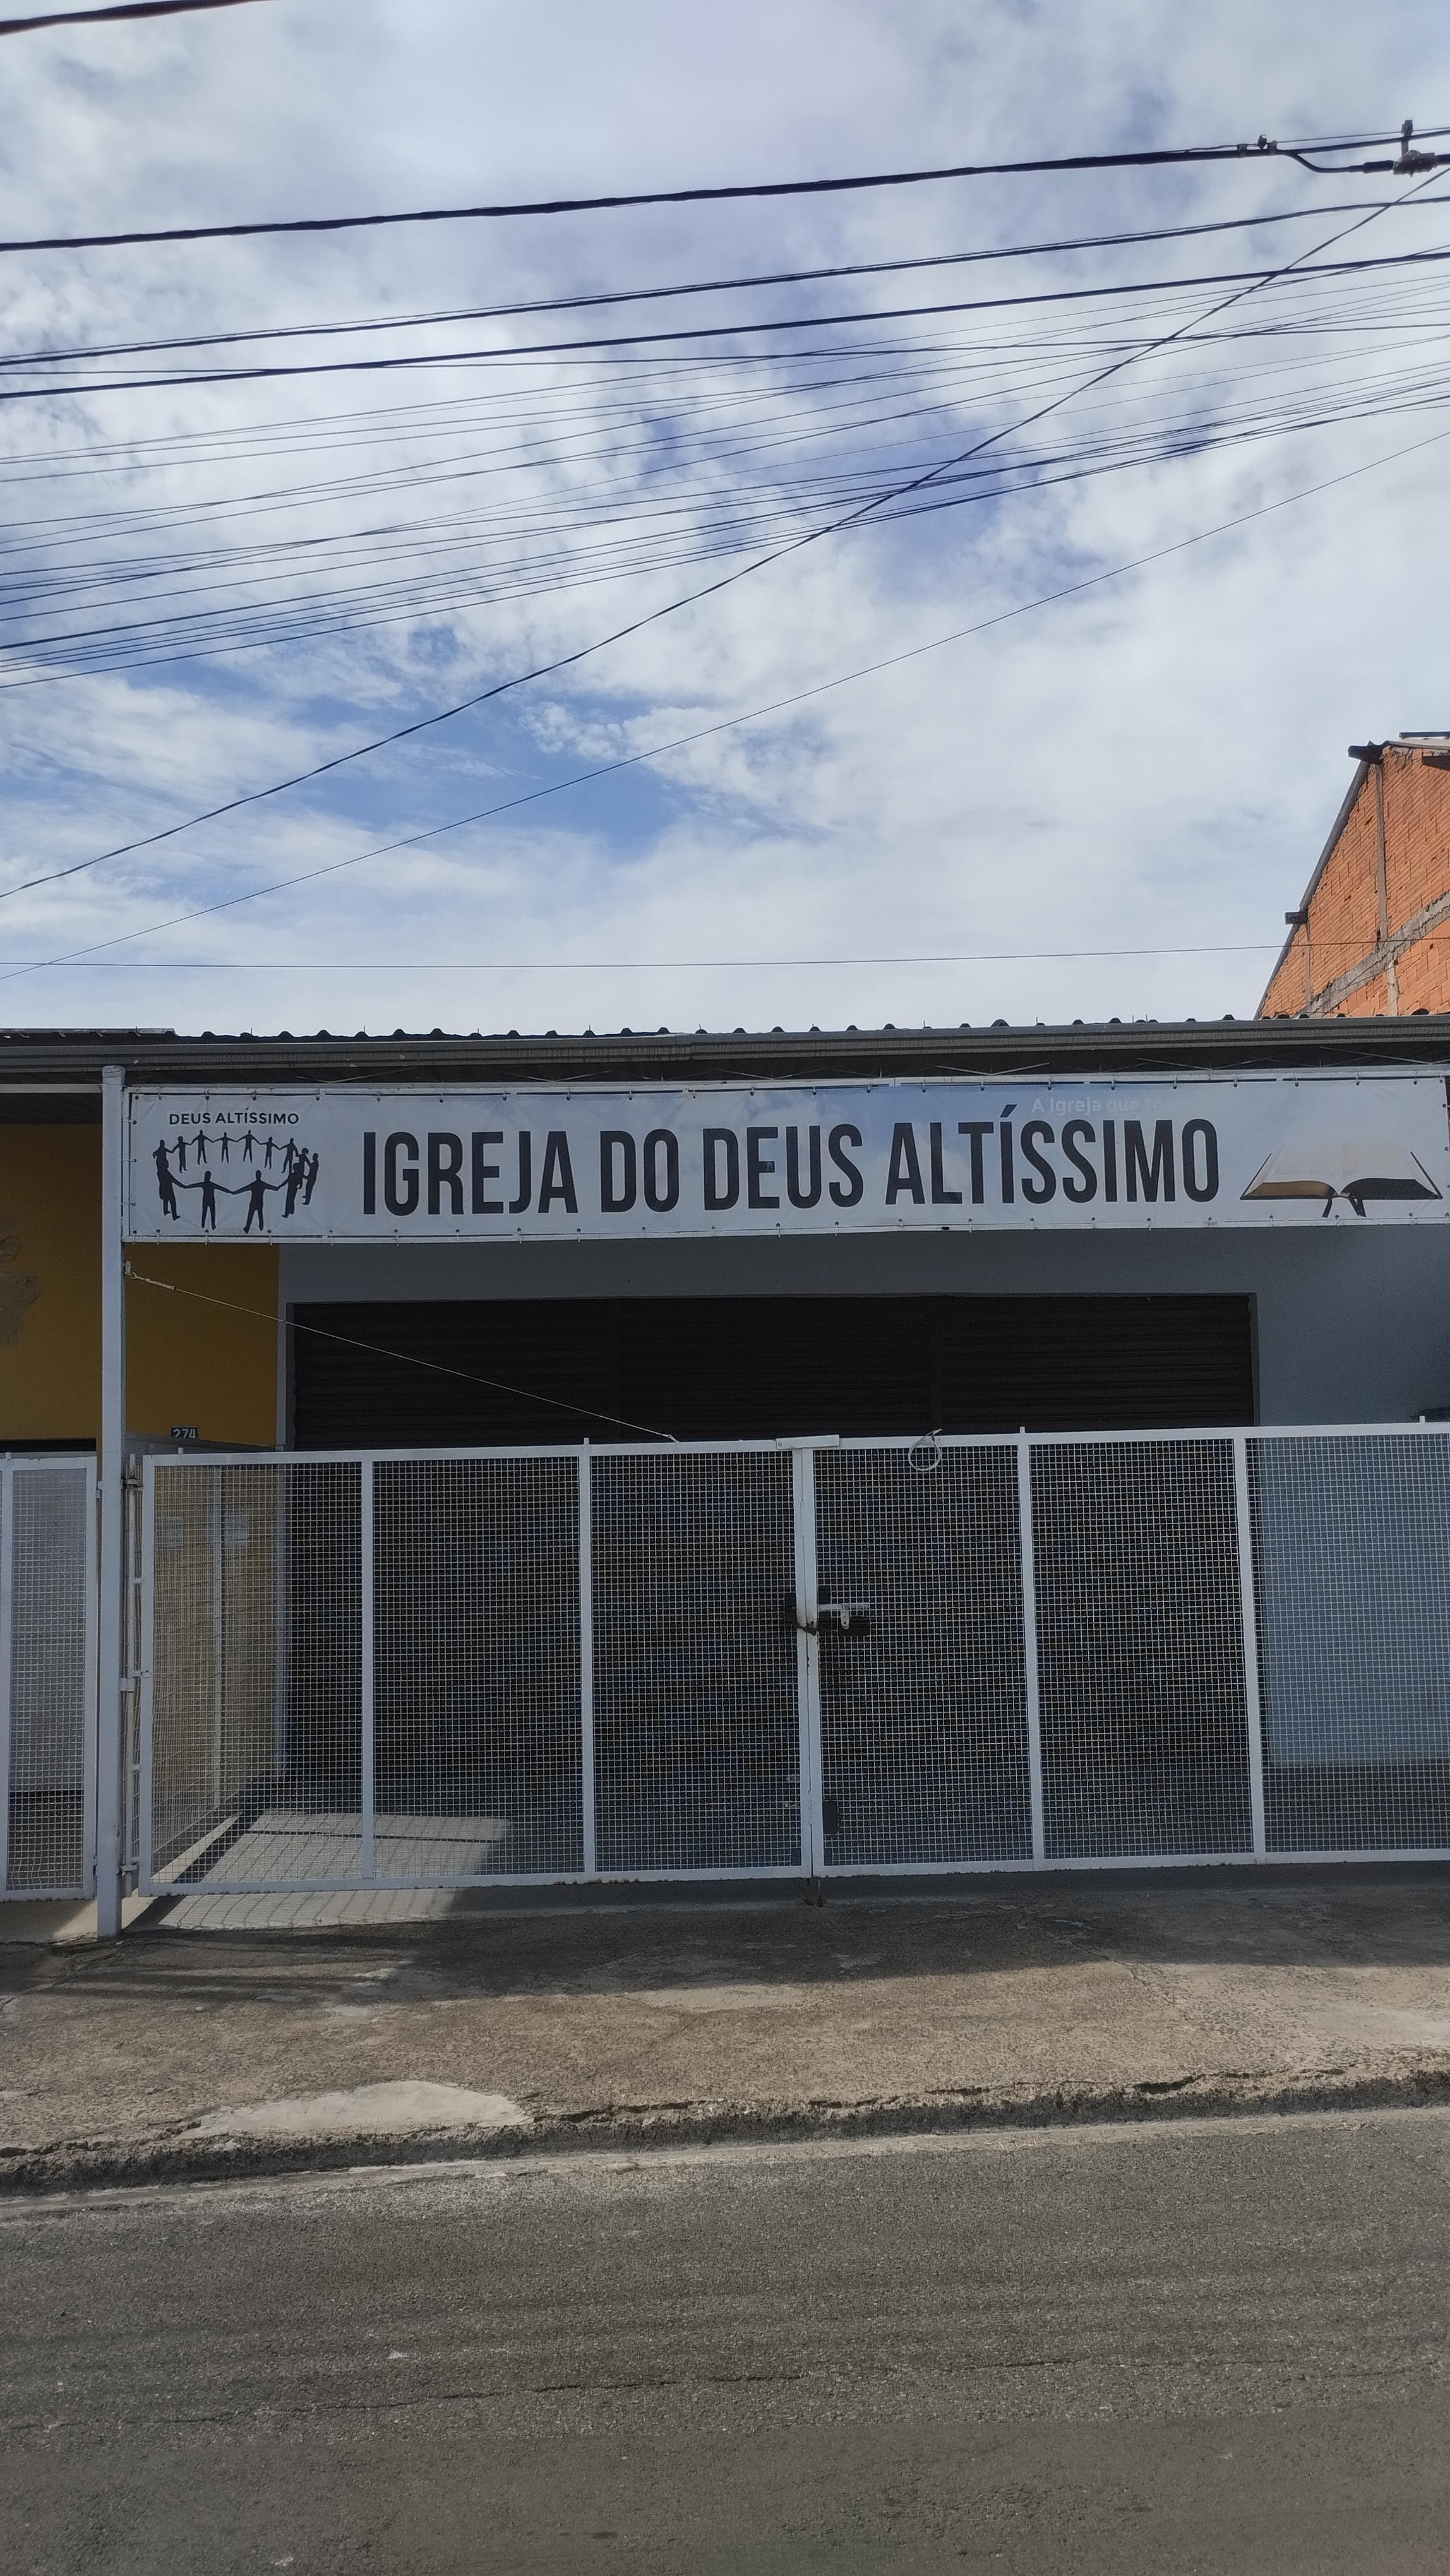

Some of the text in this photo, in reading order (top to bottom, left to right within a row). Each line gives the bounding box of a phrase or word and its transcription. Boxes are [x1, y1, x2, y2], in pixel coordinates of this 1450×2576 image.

[1031, 1098, 1045, 1113] A
[1049, 1096, 1101, 1116] Igreja
[169, 1107, 299, 1124] DEUS ALTÍSSIMO
[363, 1104, 1219, 1217] IGREJA DO DEUS ALTÍSSIMO
[173, 1428, 196, 1439] 274
